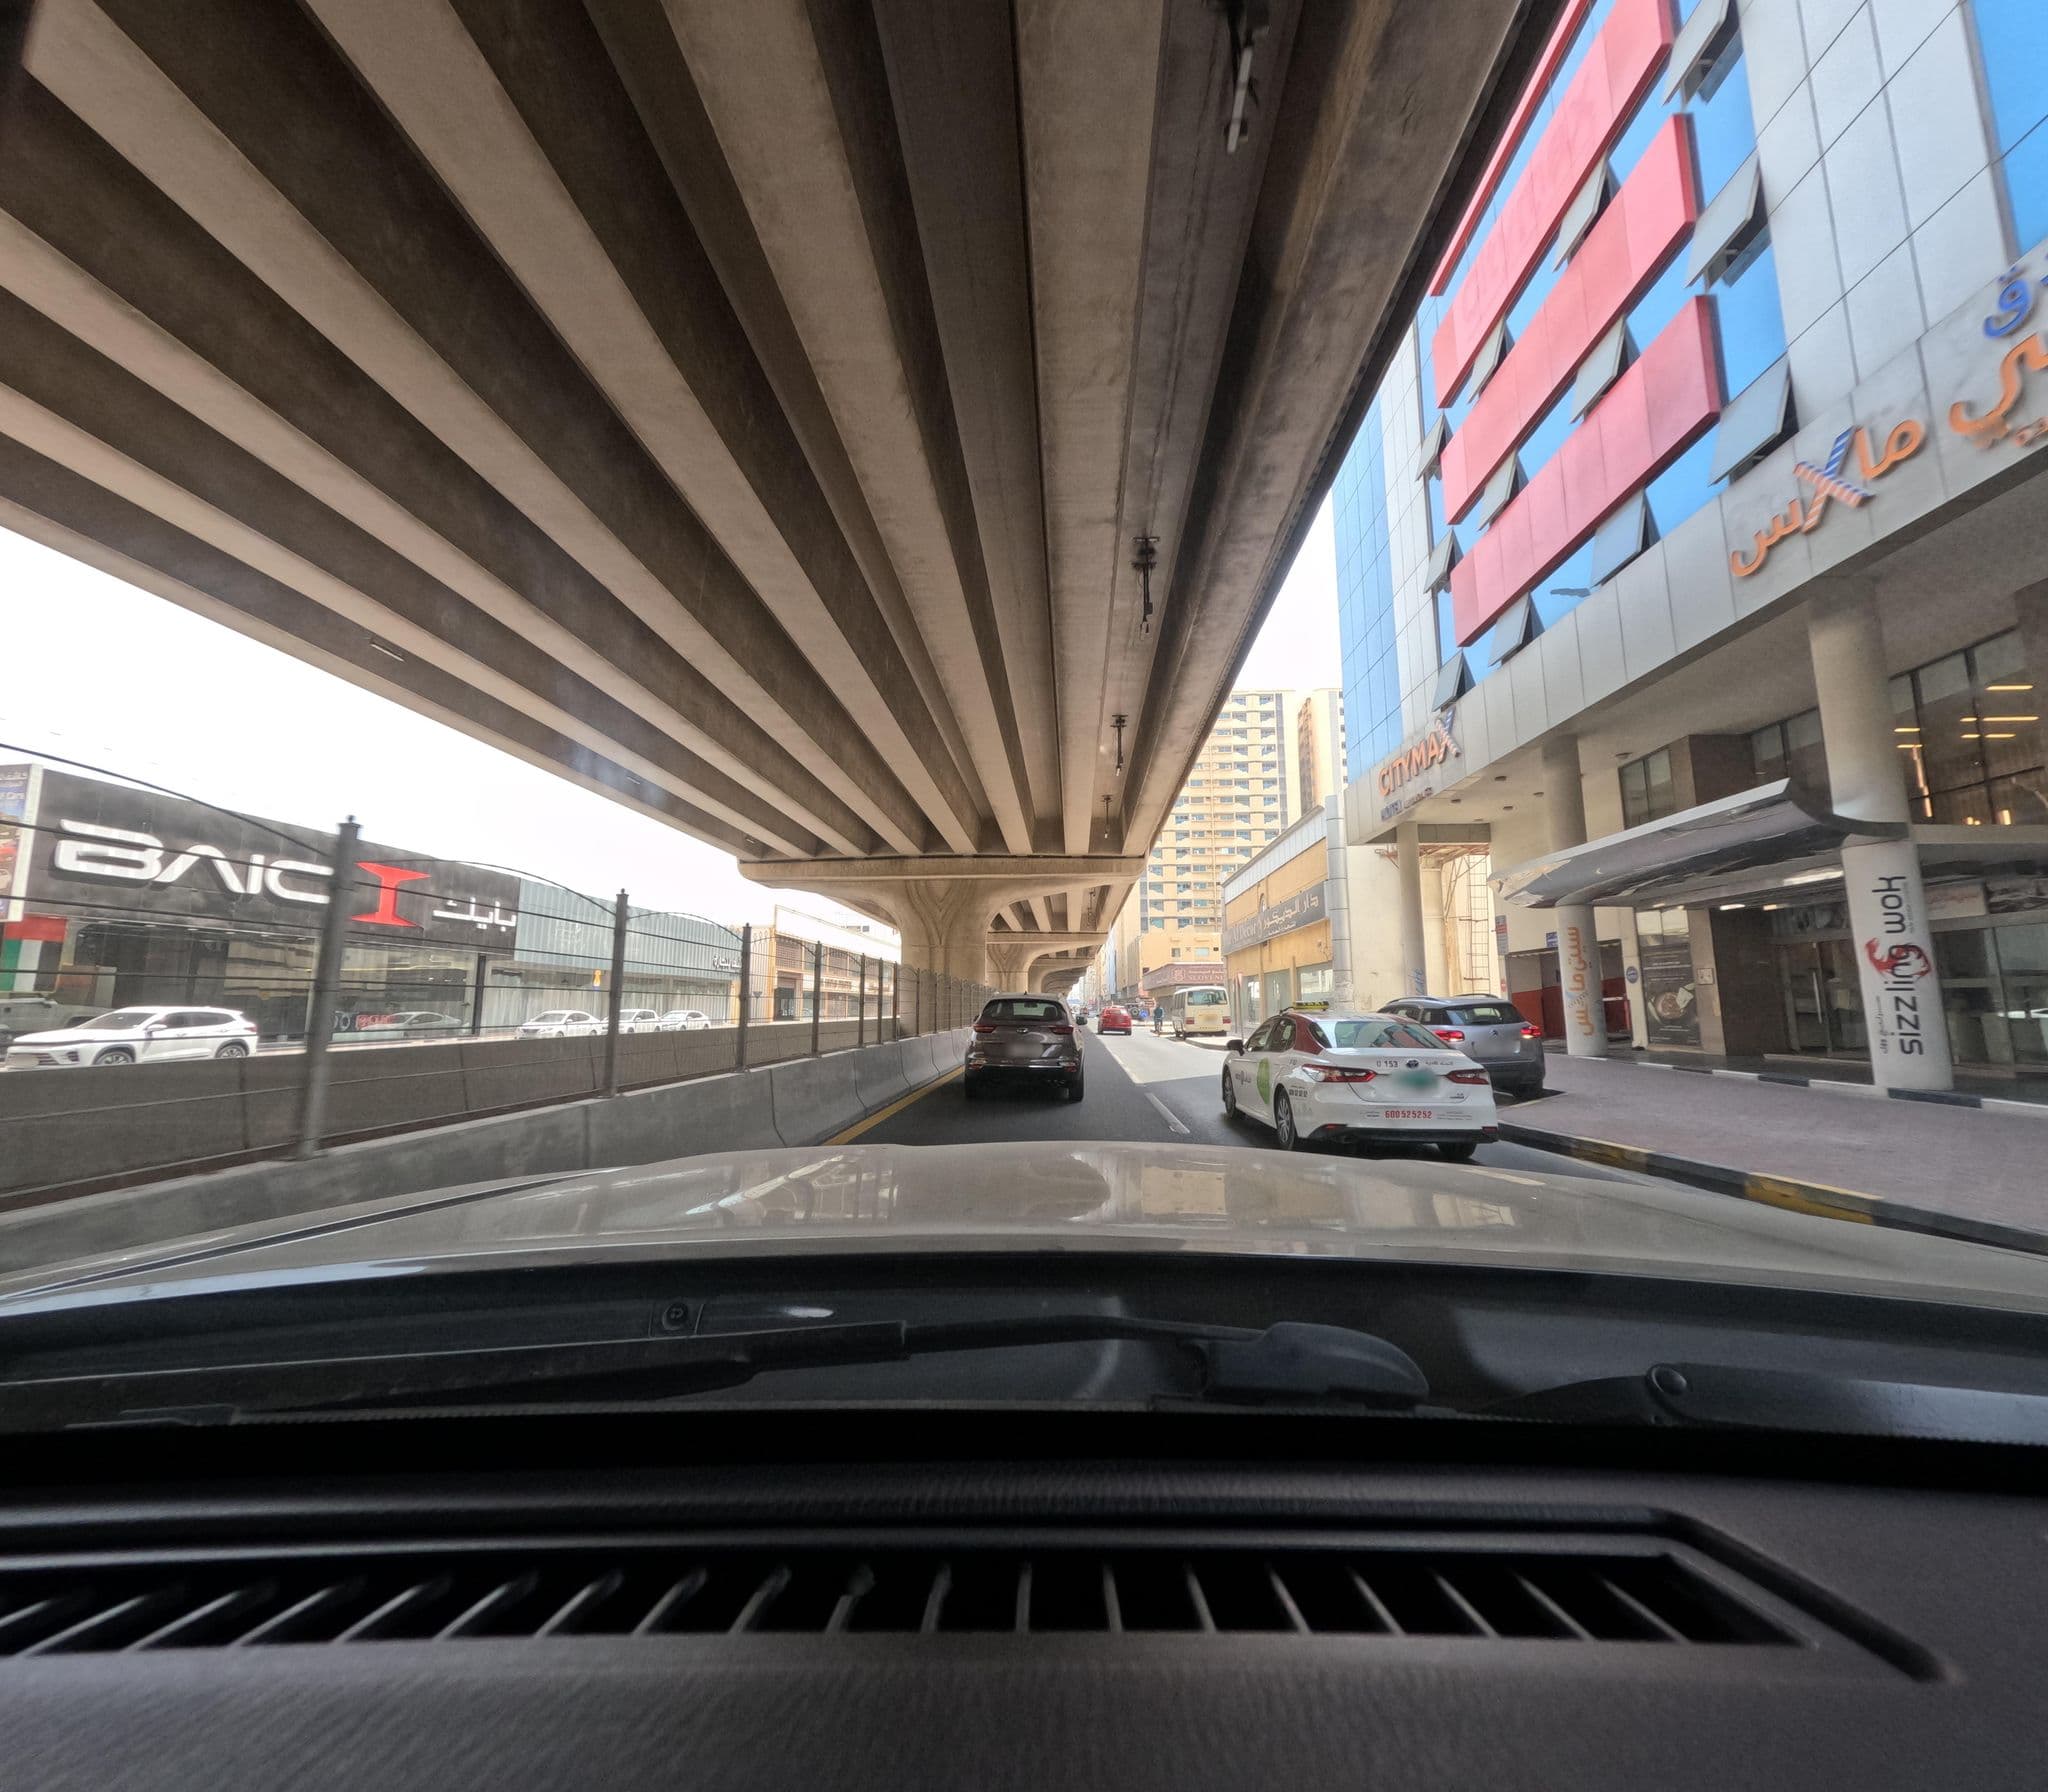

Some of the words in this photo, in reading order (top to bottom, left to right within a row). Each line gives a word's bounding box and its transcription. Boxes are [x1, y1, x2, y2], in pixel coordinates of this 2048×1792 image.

[1378, 704, 1461, 797] CITYMAX
[55, 819, 333, 904] BAIC
[433, 897, 517, 932] بايك
[1872, 876, 1907, 934] wok
[1385, 1110, 1432, 1119] 600525252
